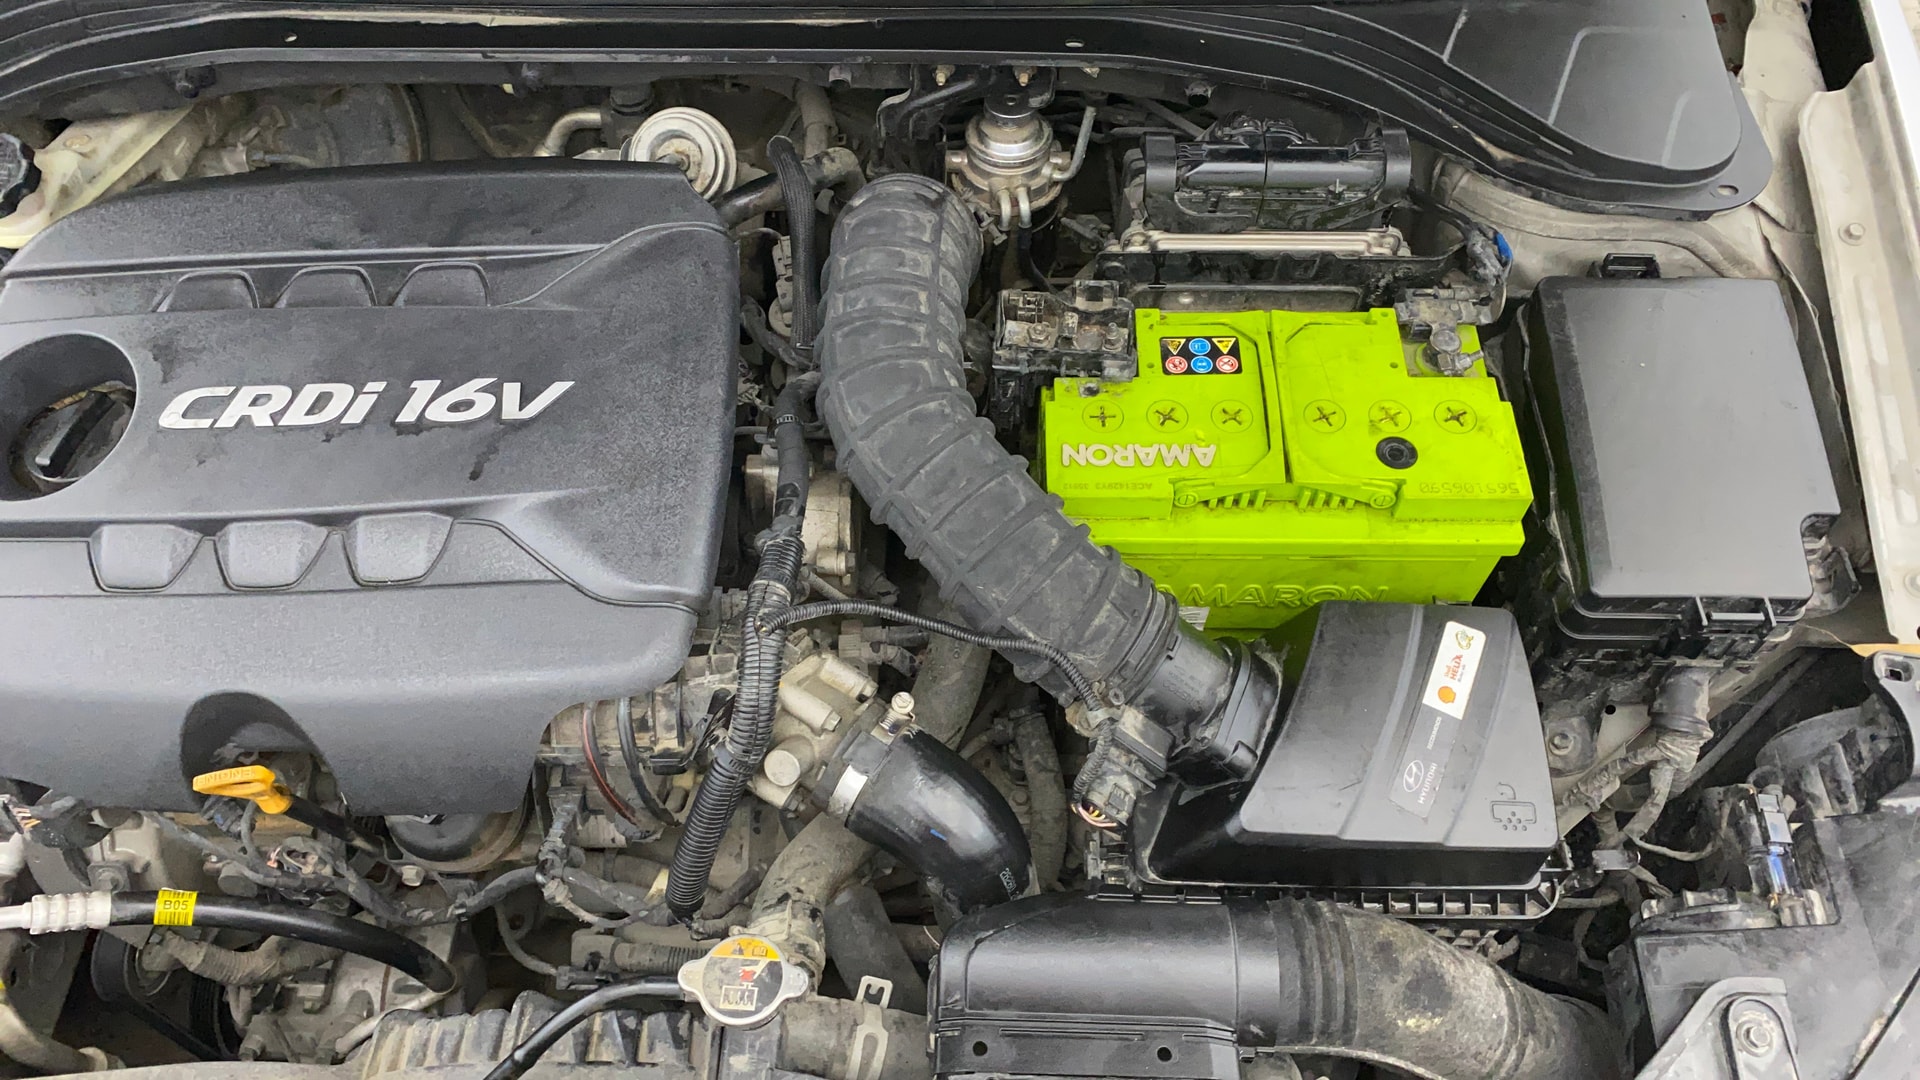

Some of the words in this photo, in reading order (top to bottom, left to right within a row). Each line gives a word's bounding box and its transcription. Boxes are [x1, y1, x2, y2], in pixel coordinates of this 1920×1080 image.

[158, 381, 388, 430] CRDi
[395, 377, 576, 423] 16V
[1061, 443, 1217, 468] AMARON
[1155, 584, 1389, 608] MARON
[1450, 654, 1464, 681] HELIX
[1417, 762, 1438, 804] HYUNDAI
[162, 900, 189, 911] B05
